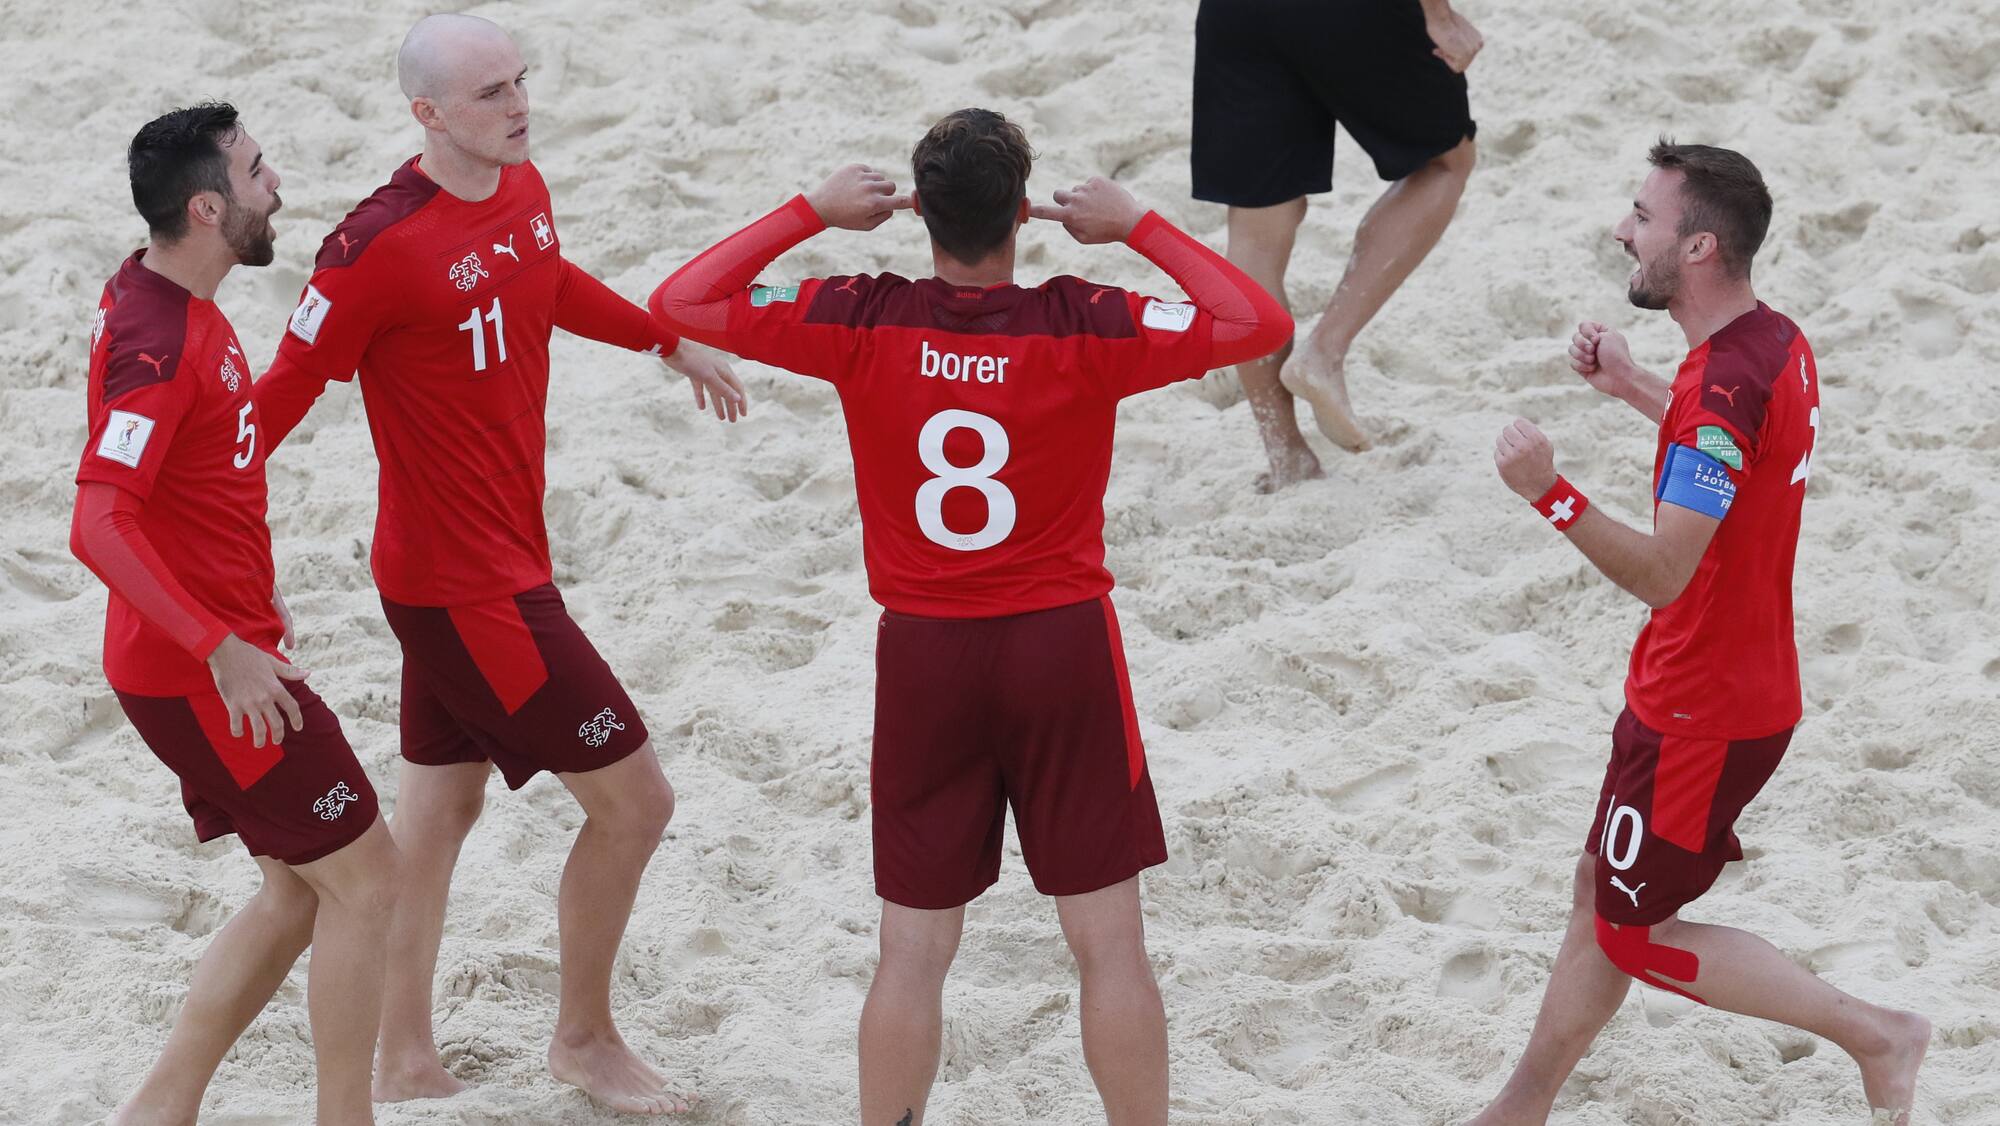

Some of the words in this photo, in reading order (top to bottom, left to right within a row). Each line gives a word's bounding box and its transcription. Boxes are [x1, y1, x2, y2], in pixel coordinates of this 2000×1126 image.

[458, 297, 507, 371] 11
[920, 341, 1009, 384] borer
[233, 400, 256, 469] 5
[915, 409, 1017, 551] 8
[1697, 463, 1729, 480] LIV
